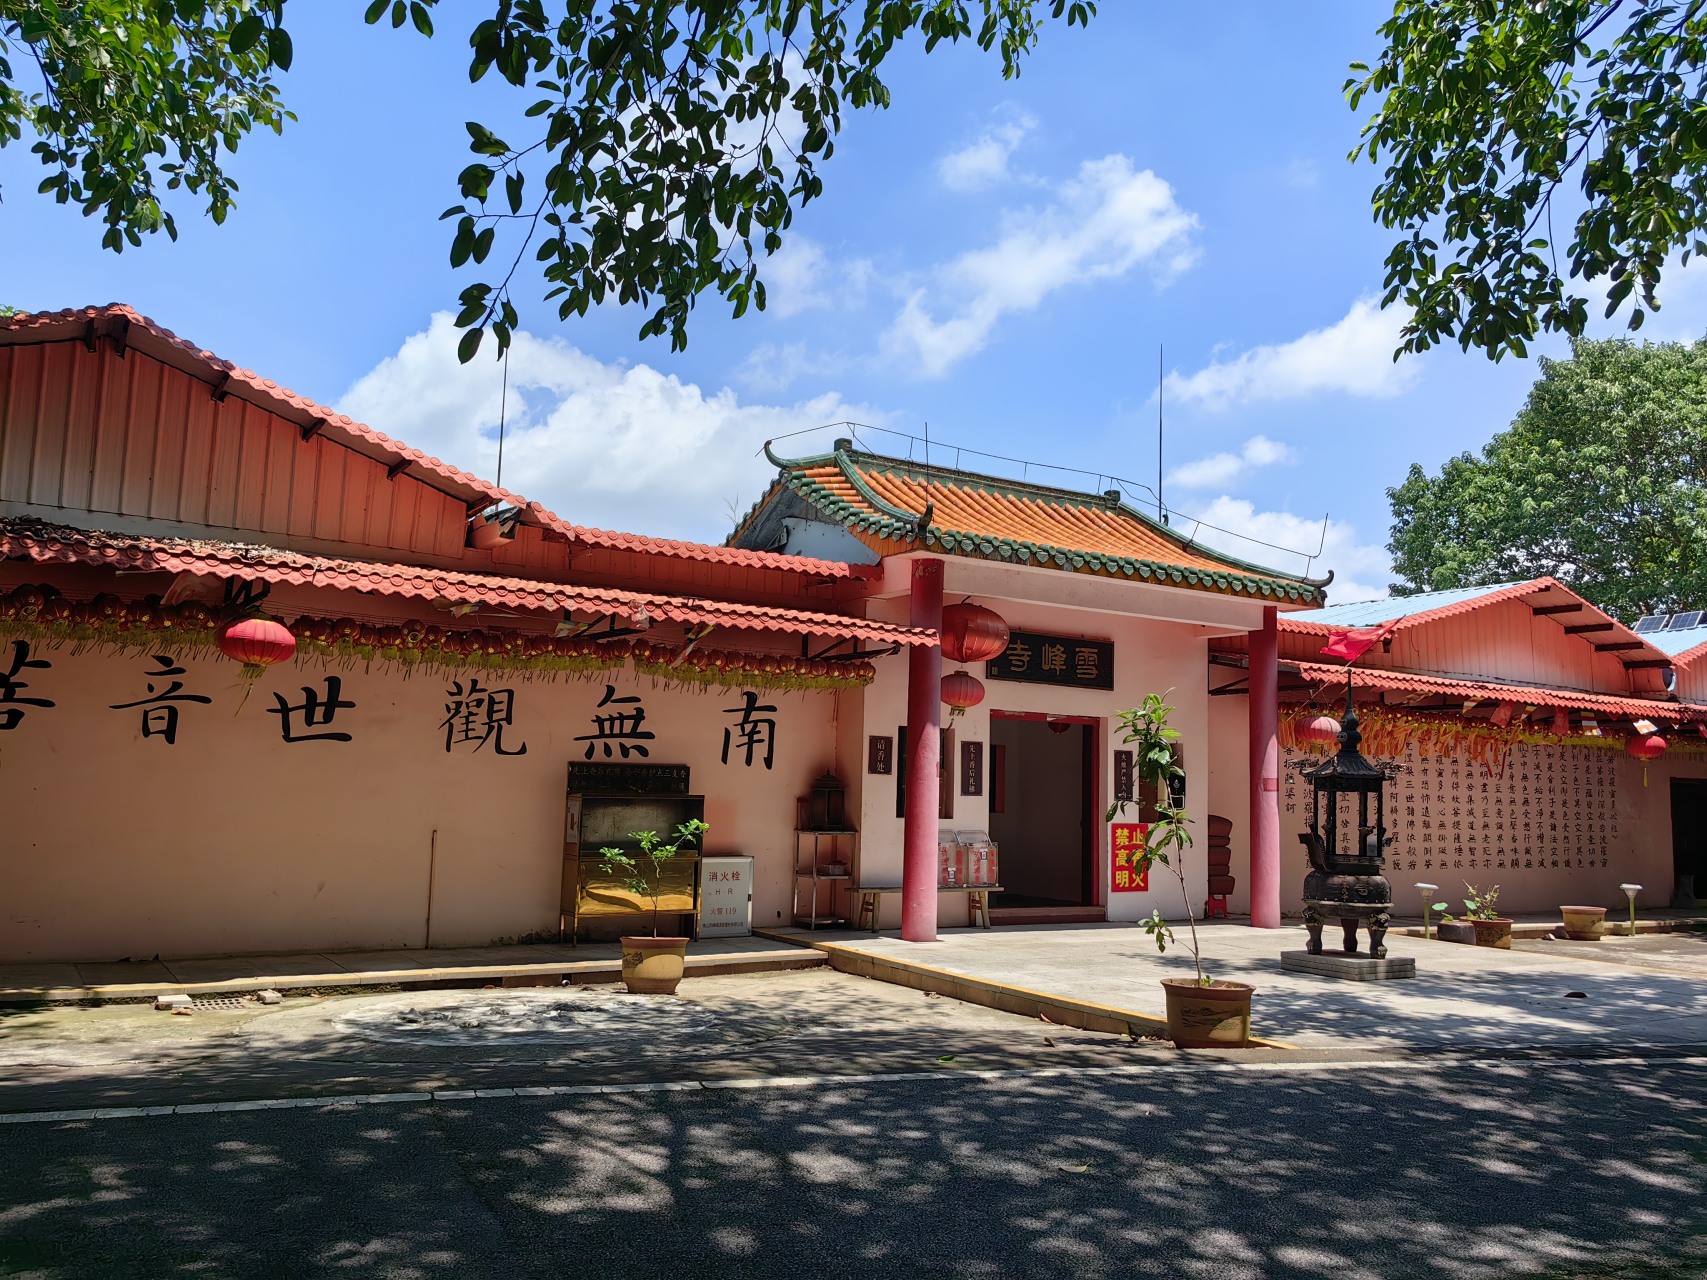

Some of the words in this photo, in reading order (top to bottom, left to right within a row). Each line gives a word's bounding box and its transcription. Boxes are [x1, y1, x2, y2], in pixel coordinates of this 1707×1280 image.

[876, 739, 886, 772] 请香处
[1115, 828, 1144, 845] 禁止
[708, 870, 741, 882] 消火栓
[1115, 871, 1145, 888] 明火
[725, 906, 737, 915] 119
